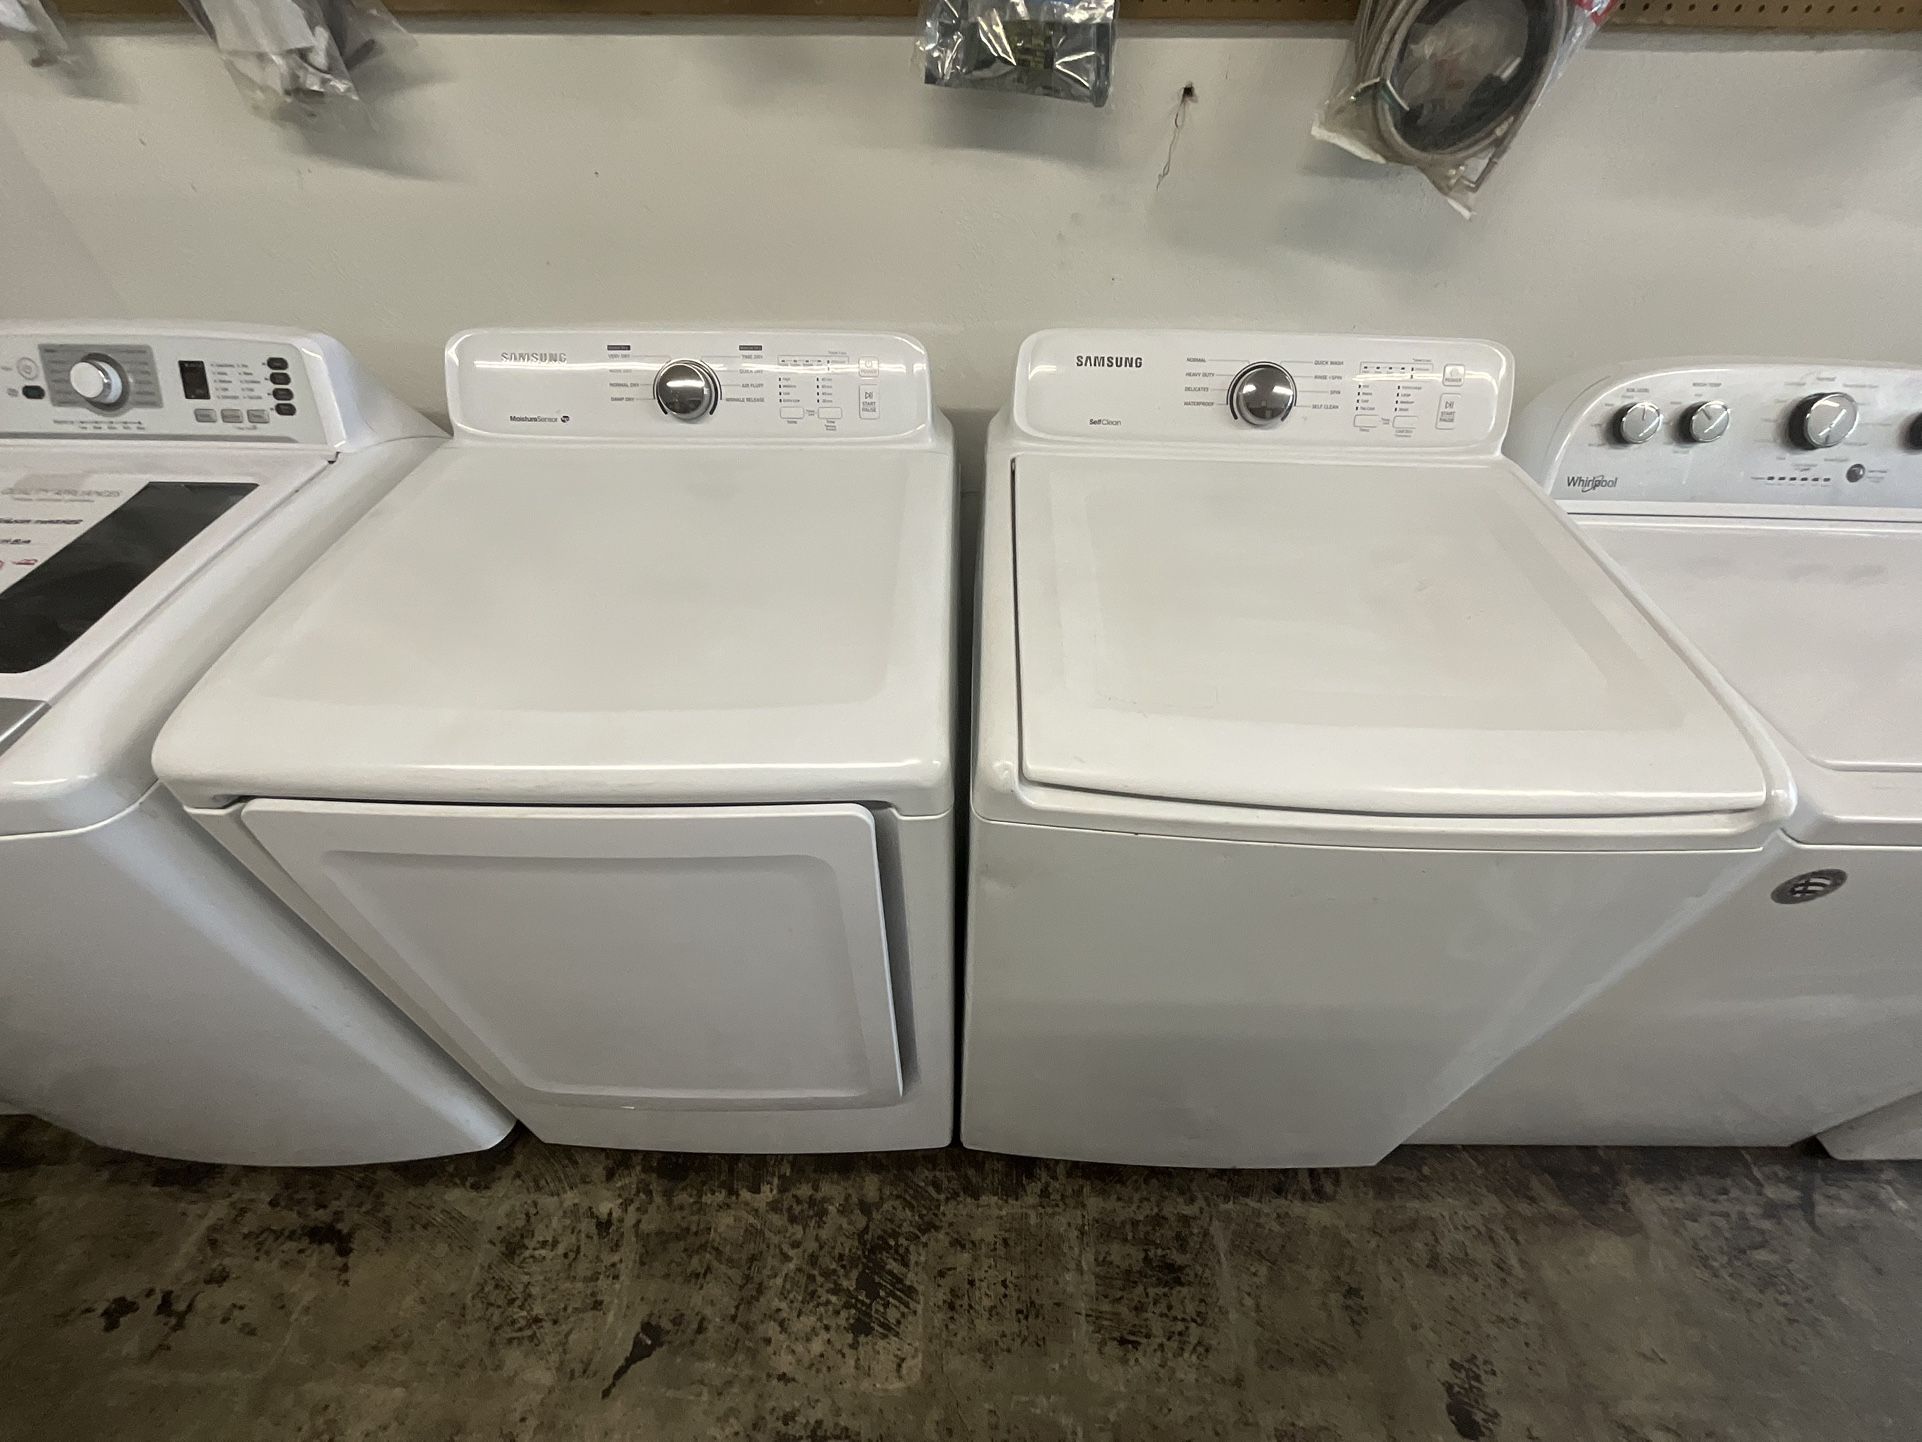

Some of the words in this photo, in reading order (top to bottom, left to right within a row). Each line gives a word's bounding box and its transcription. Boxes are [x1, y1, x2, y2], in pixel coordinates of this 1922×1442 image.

[501, 352, 568, 363] SAMSUNG
[1076, 355, 1144, 368] SAMSUNG
[510, 415, 558, 423] MoistureSensor
[1089, 418, 1122, 426] SelfClean
[1567, 474, 1618, 493] Whirlpool
